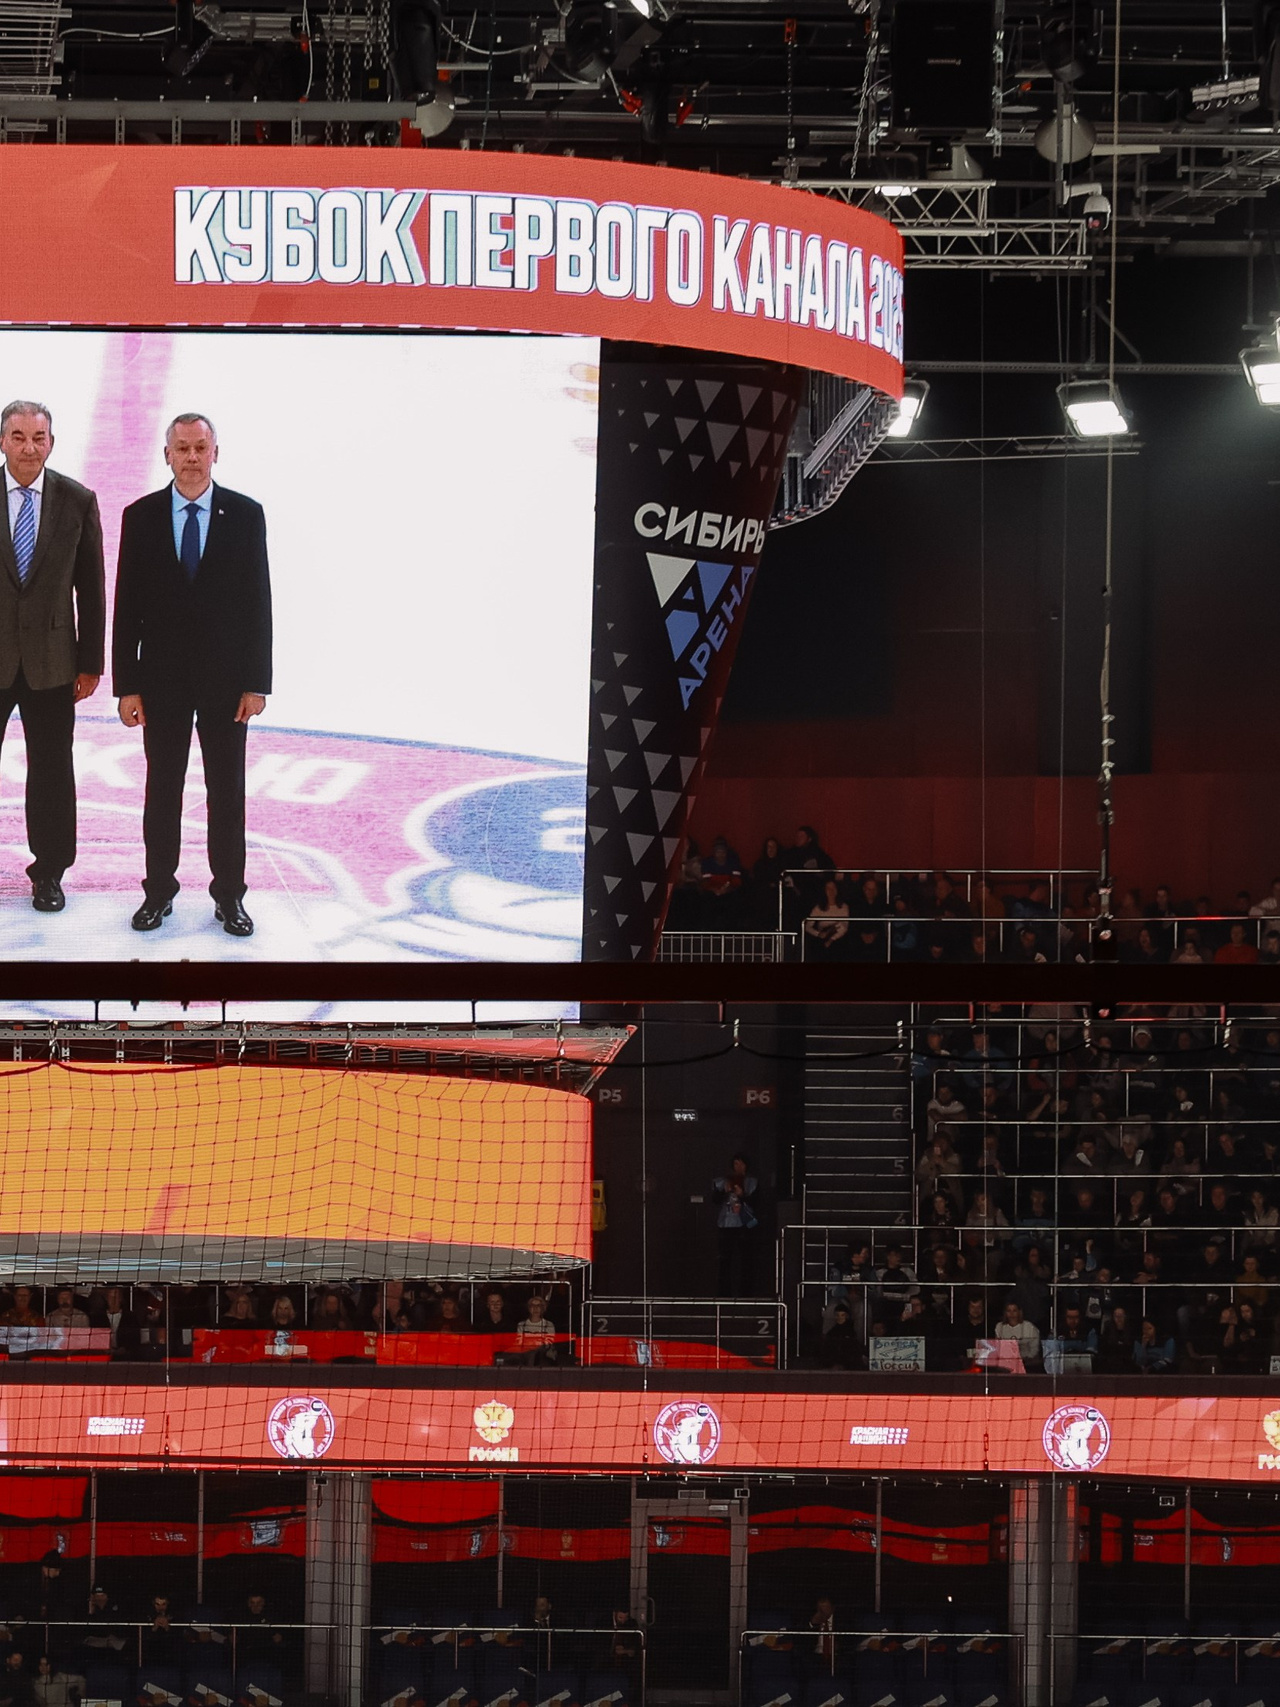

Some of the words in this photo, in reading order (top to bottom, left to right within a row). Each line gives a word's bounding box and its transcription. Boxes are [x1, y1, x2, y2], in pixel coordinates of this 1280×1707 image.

[174, 186, 426, 286] КУБОК
[428, 190, 704, 308] ПЕРВОГО
[710, 213, 867, 344] КАНАЛА
[634, 502, 766, 554] СИБИРЬ
[678, 566, 755, 711] АРЕНА
[892, 1107, 903, 1121] 6
[894, 1160, 904, 1173] 5
[596, 1318, 608, 1333] 2
[757, 1320, 770, 1334] 2
